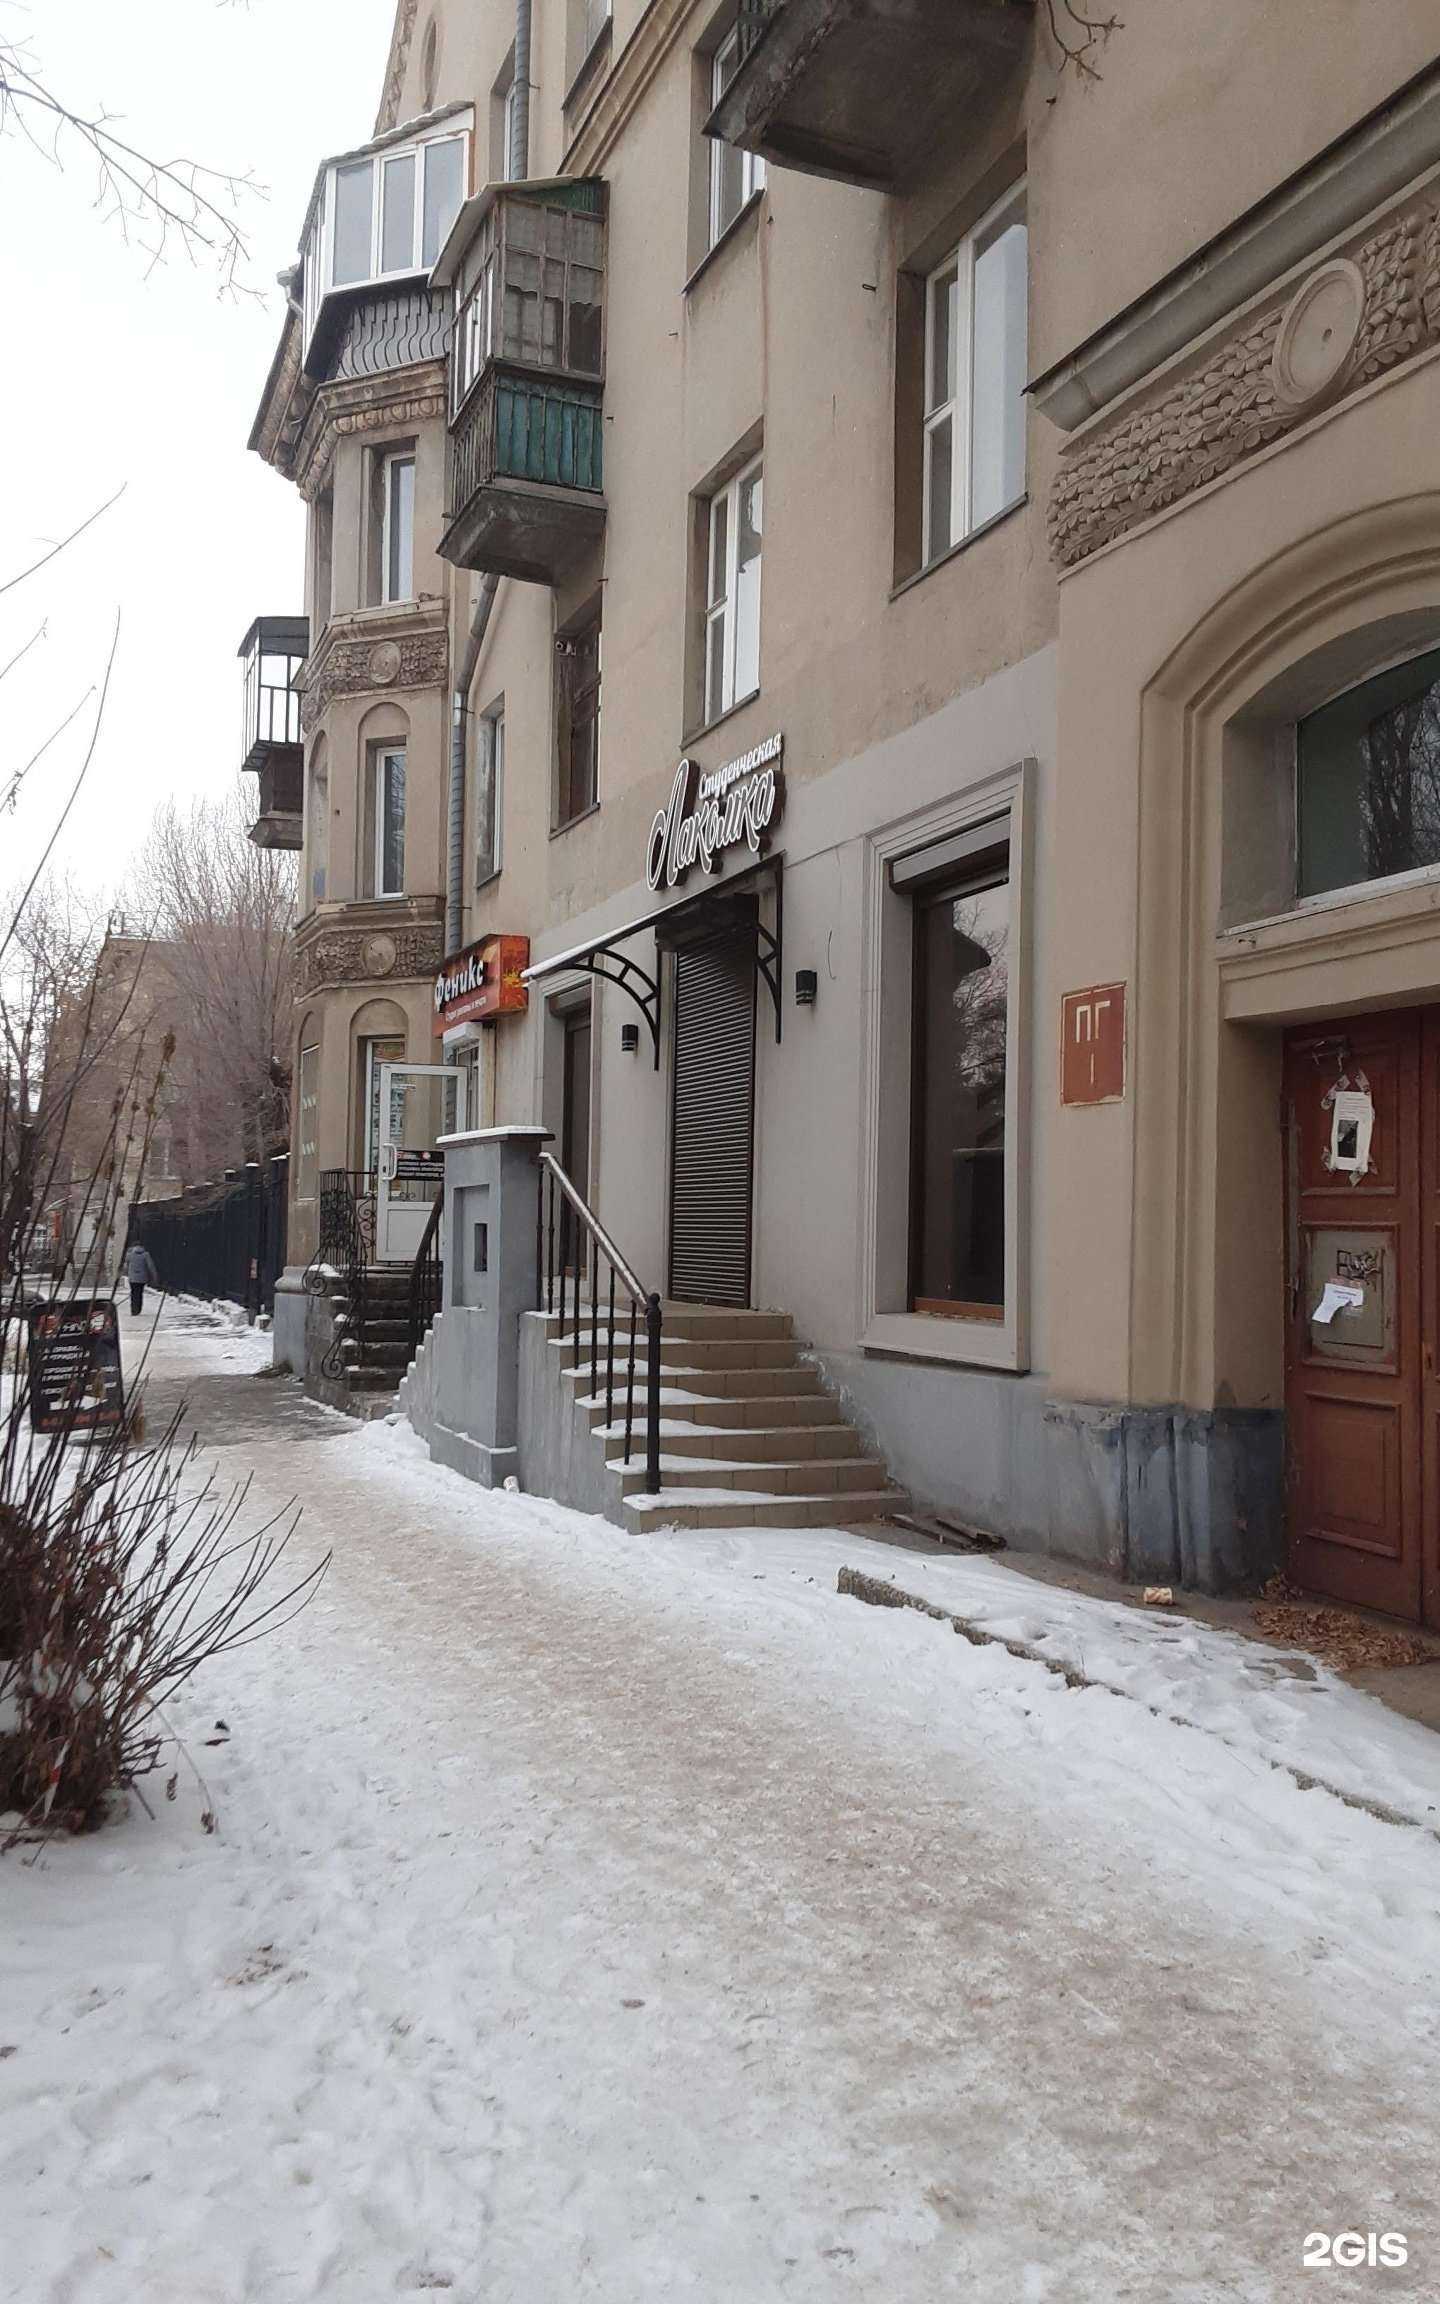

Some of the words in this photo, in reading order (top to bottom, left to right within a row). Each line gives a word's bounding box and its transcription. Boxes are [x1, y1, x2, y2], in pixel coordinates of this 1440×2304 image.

[699, 732, 781, 800] Студенческая
[646, 758, 777, 891] Лакомка
[434, 955, 484, 1013] Феникс
[1076, 1000, 1111, 1043] ПГ
